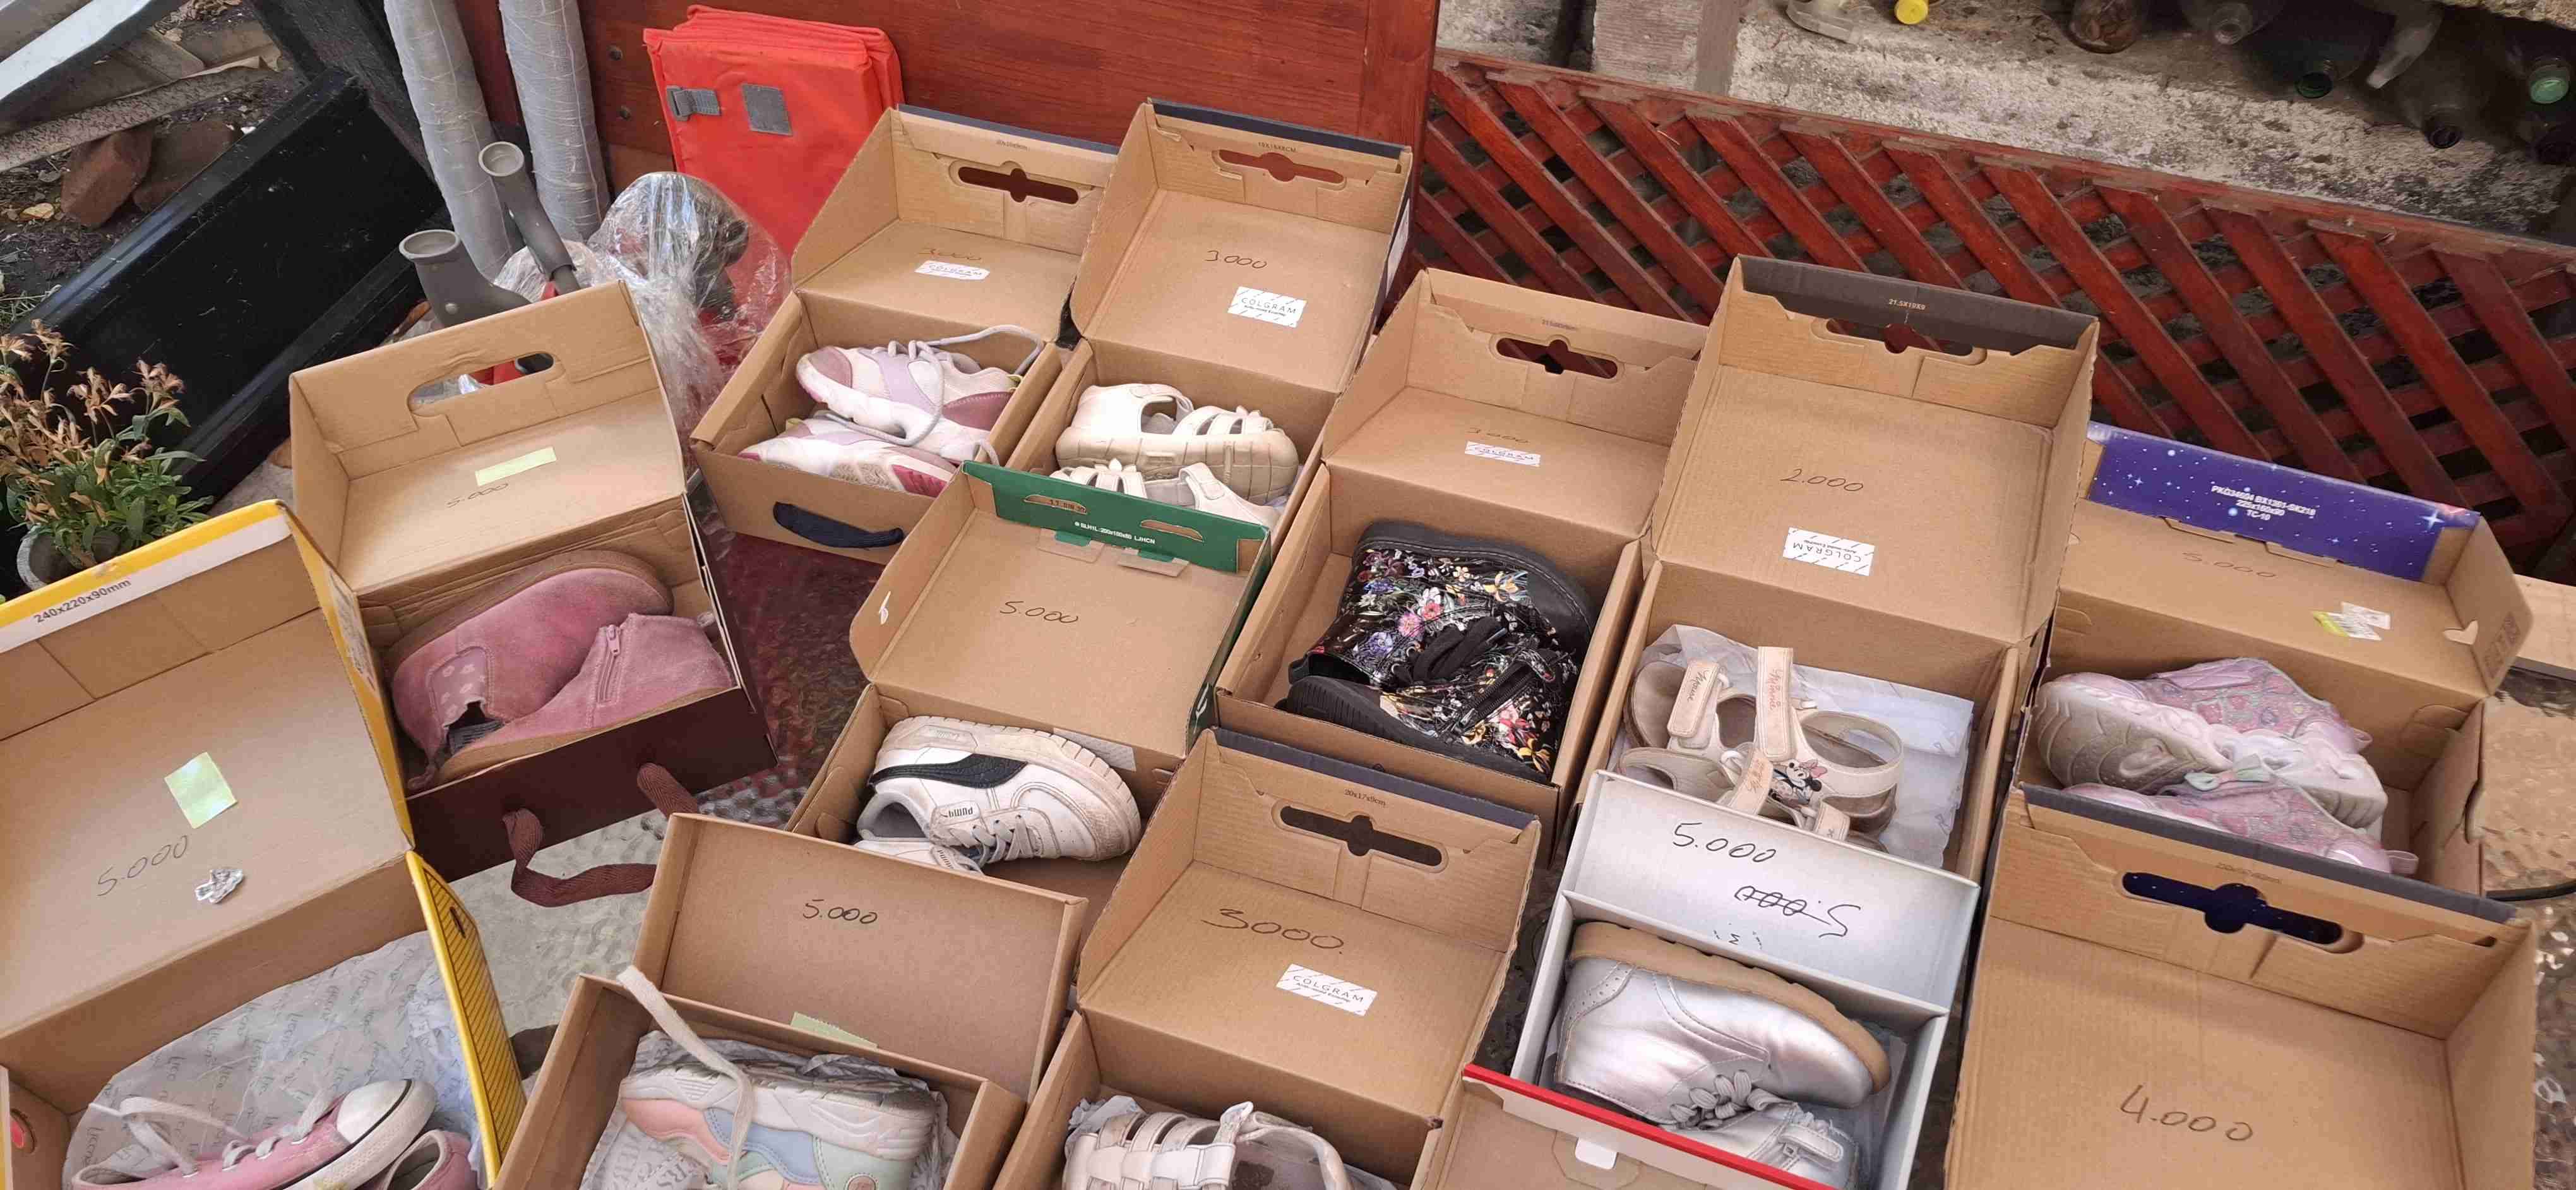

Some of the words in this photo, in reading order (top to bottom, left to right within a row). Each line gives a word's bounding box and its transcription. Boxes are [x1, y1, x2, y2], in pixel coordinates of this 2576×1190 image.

[1205, 250, 1267, 268] 3.000
[1241, 298, 1296, 313] COLGRAM
[1780, 469, 1864, 491] 2.000
[1792, 542, 1861, 563] COLGRAM
[2182, 552, 2275, 577] 5.000
[33, 579, 131, 623] 240x220x90mm
[999, 601, 1079, 623] 5.000
[1673, 822, 1777, 863] 5.000
[96, 834, 188, 897] 5.000
[802, 899, 878, 924] 5.000
[1293, 975, 1364, 1003] COLGRAM
[2120, 1084, 2253, 1141] 4.000
